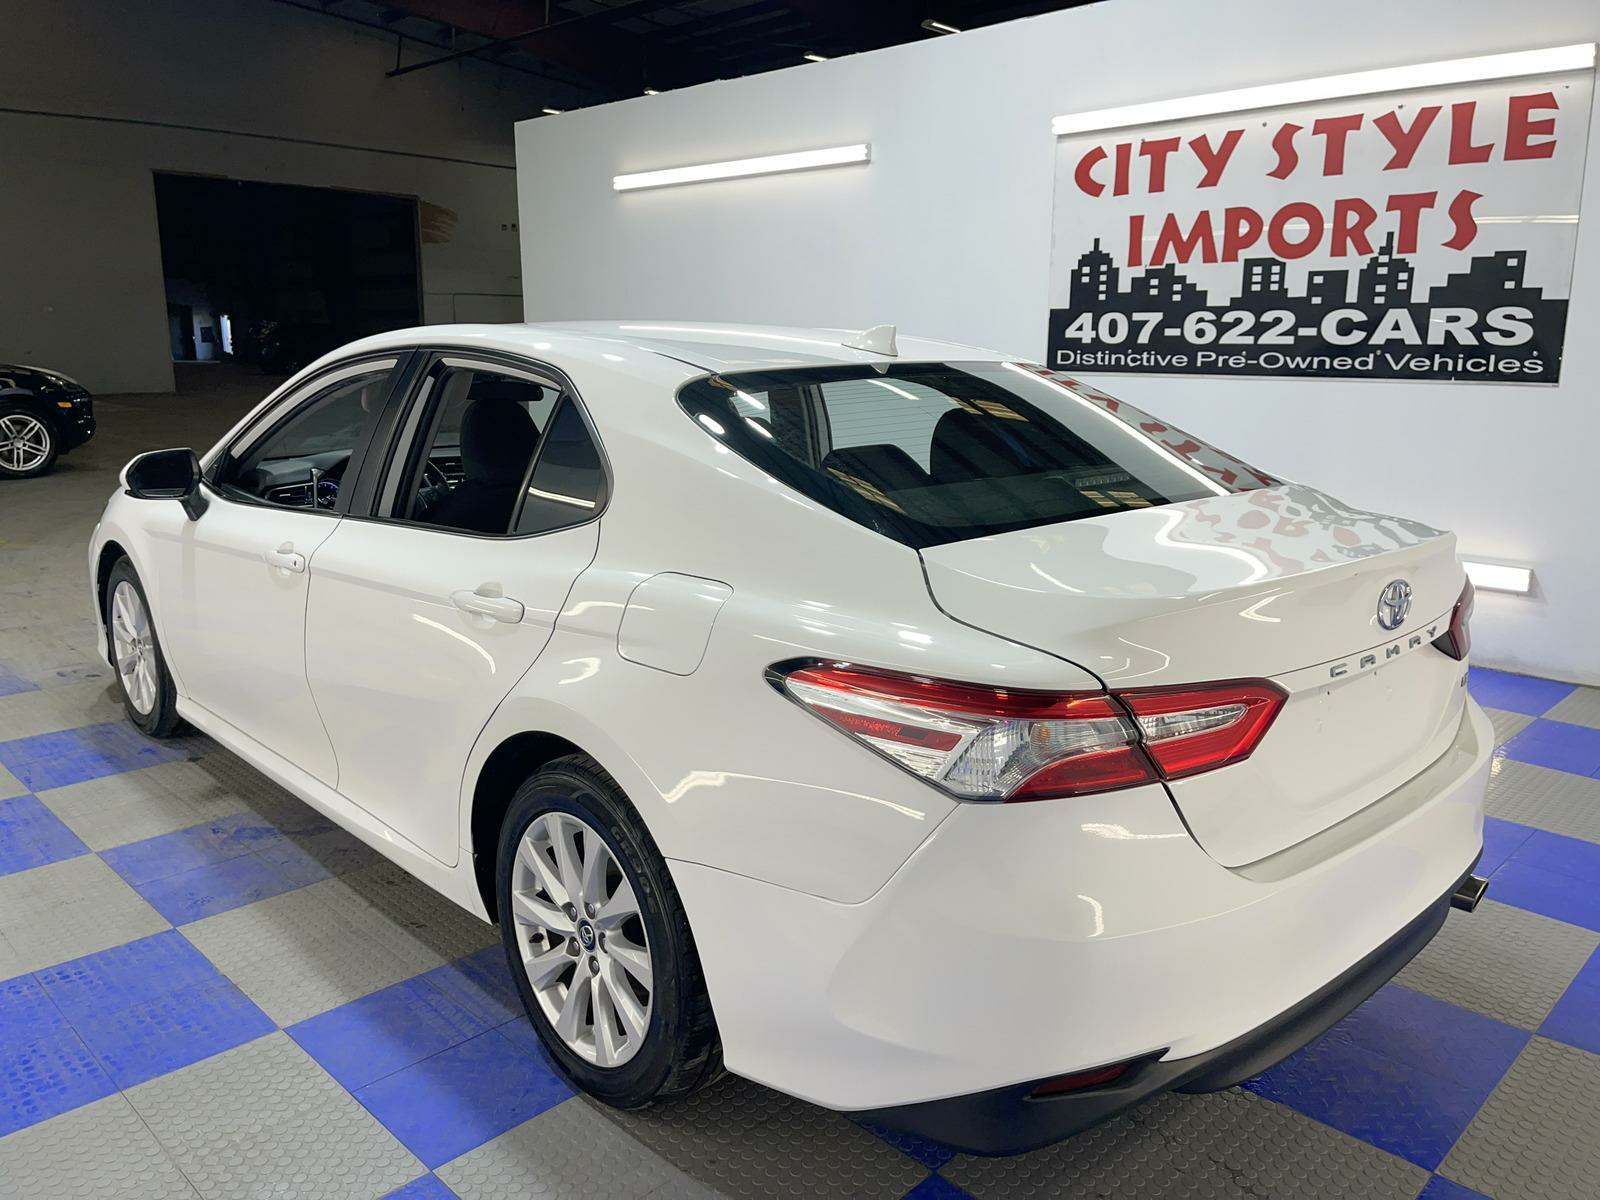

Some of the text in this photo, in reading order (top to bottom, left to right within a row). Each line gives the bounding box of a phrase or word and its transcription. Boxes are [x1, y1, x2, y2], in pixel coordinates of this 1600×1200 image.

[1074, 92, 1559, 198] CITY STYLE
[1127, 189, 1484, 268] IMPORTS
[1064, 307, 1535, 346] 407-622-CARS
[1056, 350, 1546, 374] Distinctive Pre-Owned Vehicles
[1330, 626, 1437, 678] CAMRY
